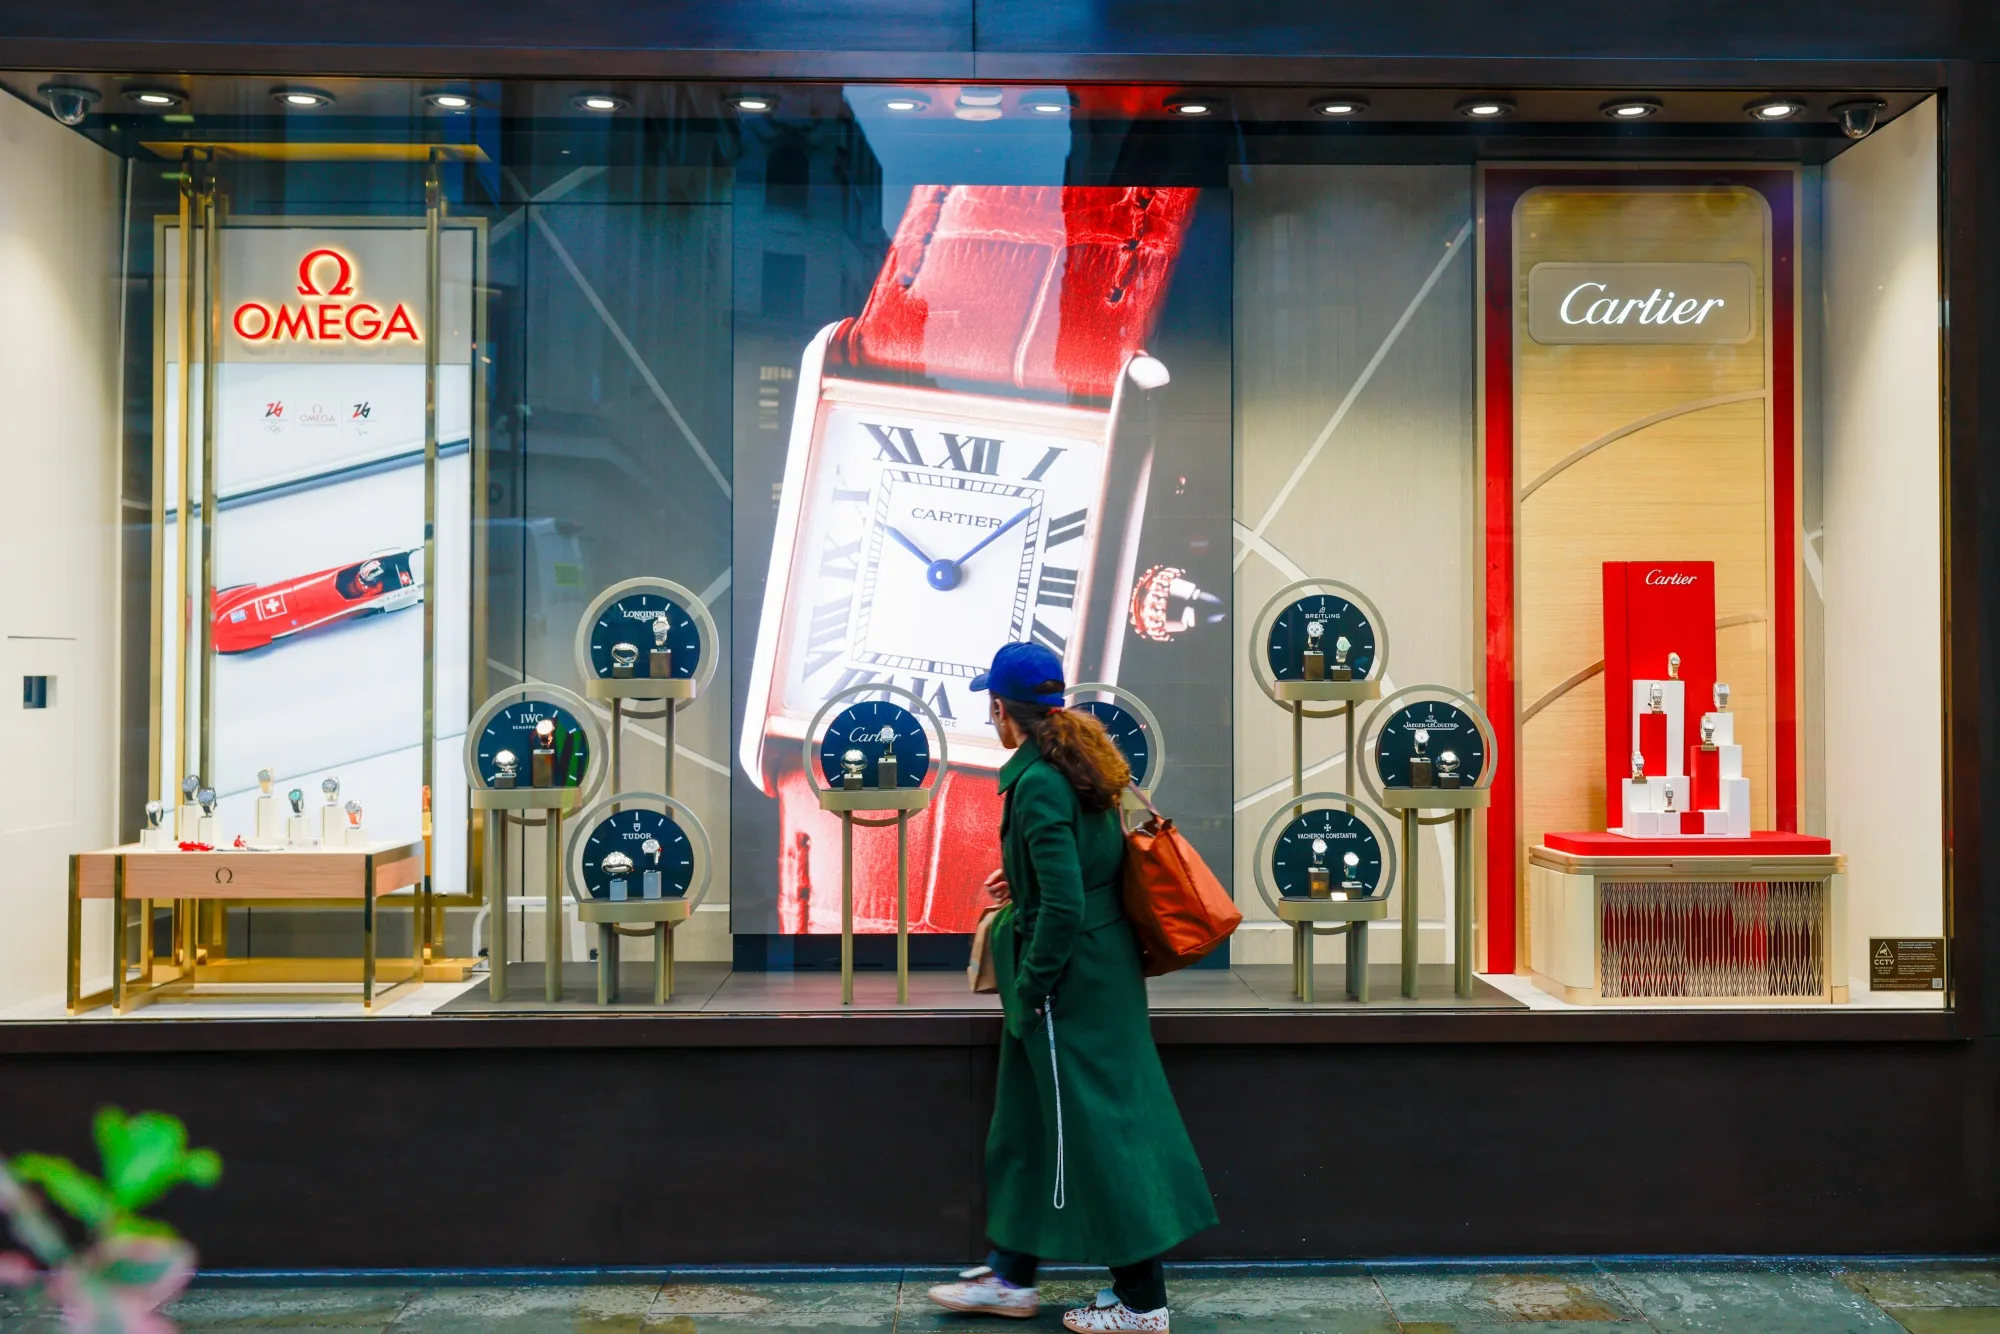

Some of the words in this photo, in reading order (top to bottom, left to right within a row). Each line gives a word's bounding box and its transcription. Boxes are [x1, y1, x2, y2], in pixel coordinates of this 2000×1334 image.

[1560, 282, 1725, 325] Cartier
[234, 303, 419, 340] OMEGA
[299, 414, 335, 422] OMEGA
[933, 432, 1005, 476] XII
[911, 507, 1004, 530] CARTIER
[1645, 569, 1697, 585] Cartier
[520, 713, 544, 724] IWC
[849, 727, 901, 742] Cartr
